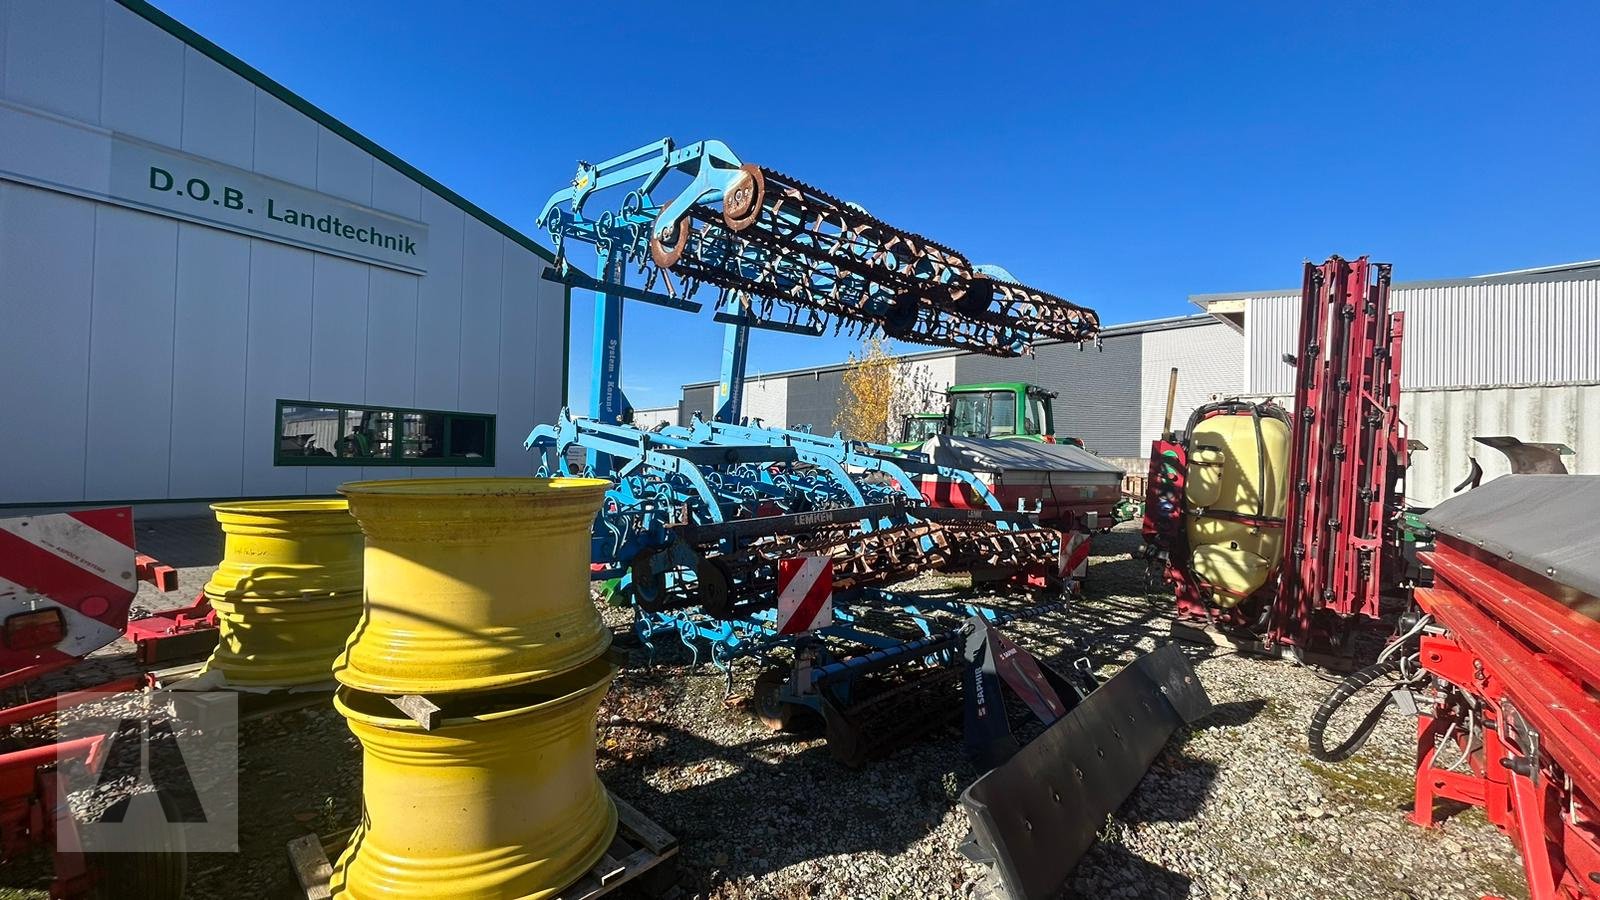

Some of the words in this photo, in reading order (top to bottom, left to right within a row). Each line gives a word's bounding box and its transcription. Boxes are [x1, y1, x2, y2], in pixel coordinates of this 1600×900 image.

[149, 166, 254, 215] D.O.B.
[267, 198, 417, 256] Landtechnik
[608, 339, 618, 373] System
[794, 511, 833, 526] LEMKEN
[975, 667, 985, 705] SAPHIR
